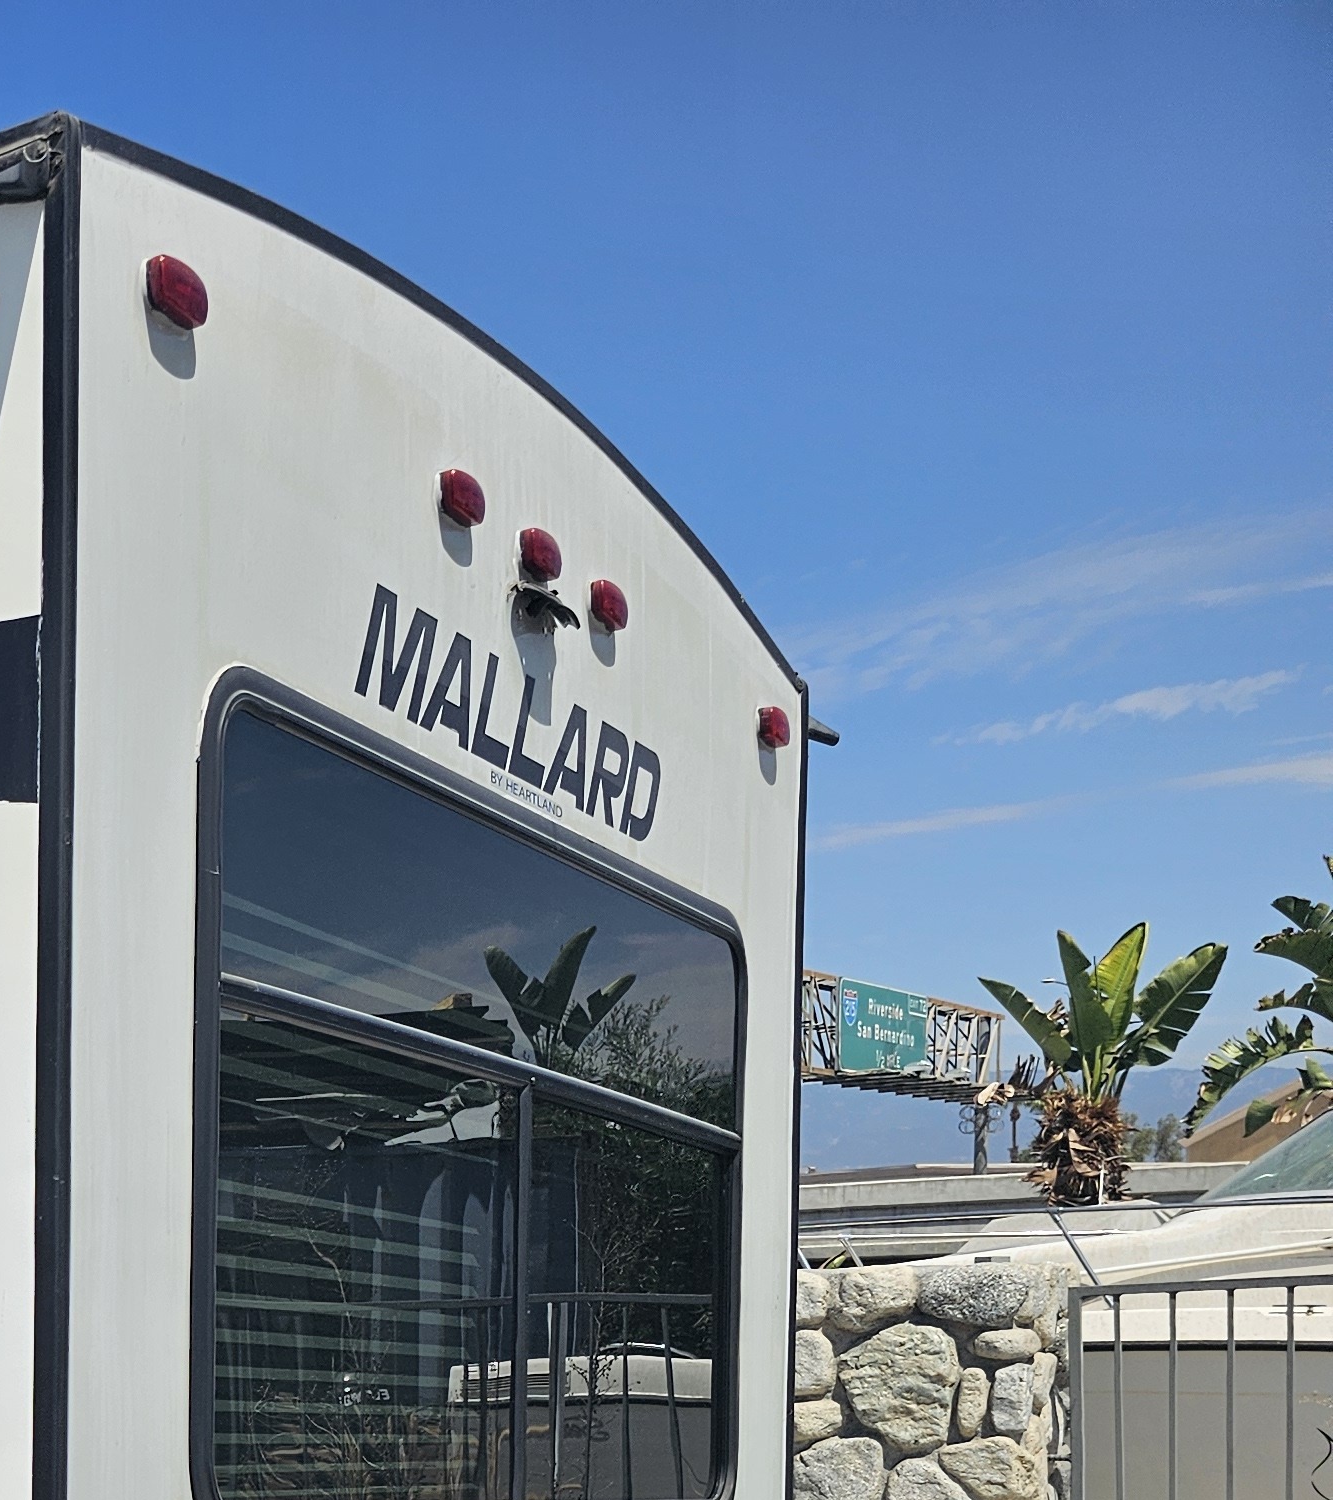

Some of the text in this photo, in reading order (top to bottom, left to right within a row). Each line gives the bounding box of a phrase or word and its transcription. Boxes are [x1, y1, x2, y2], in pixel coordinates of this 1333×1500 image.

[354, 582, 661, 842] MALLARD
[490, 770, 563, 818] BY HEARTLAND
[868, 998, 903, 1020] Riverside
[857, 1020, 915, 1047] San Bernardino
